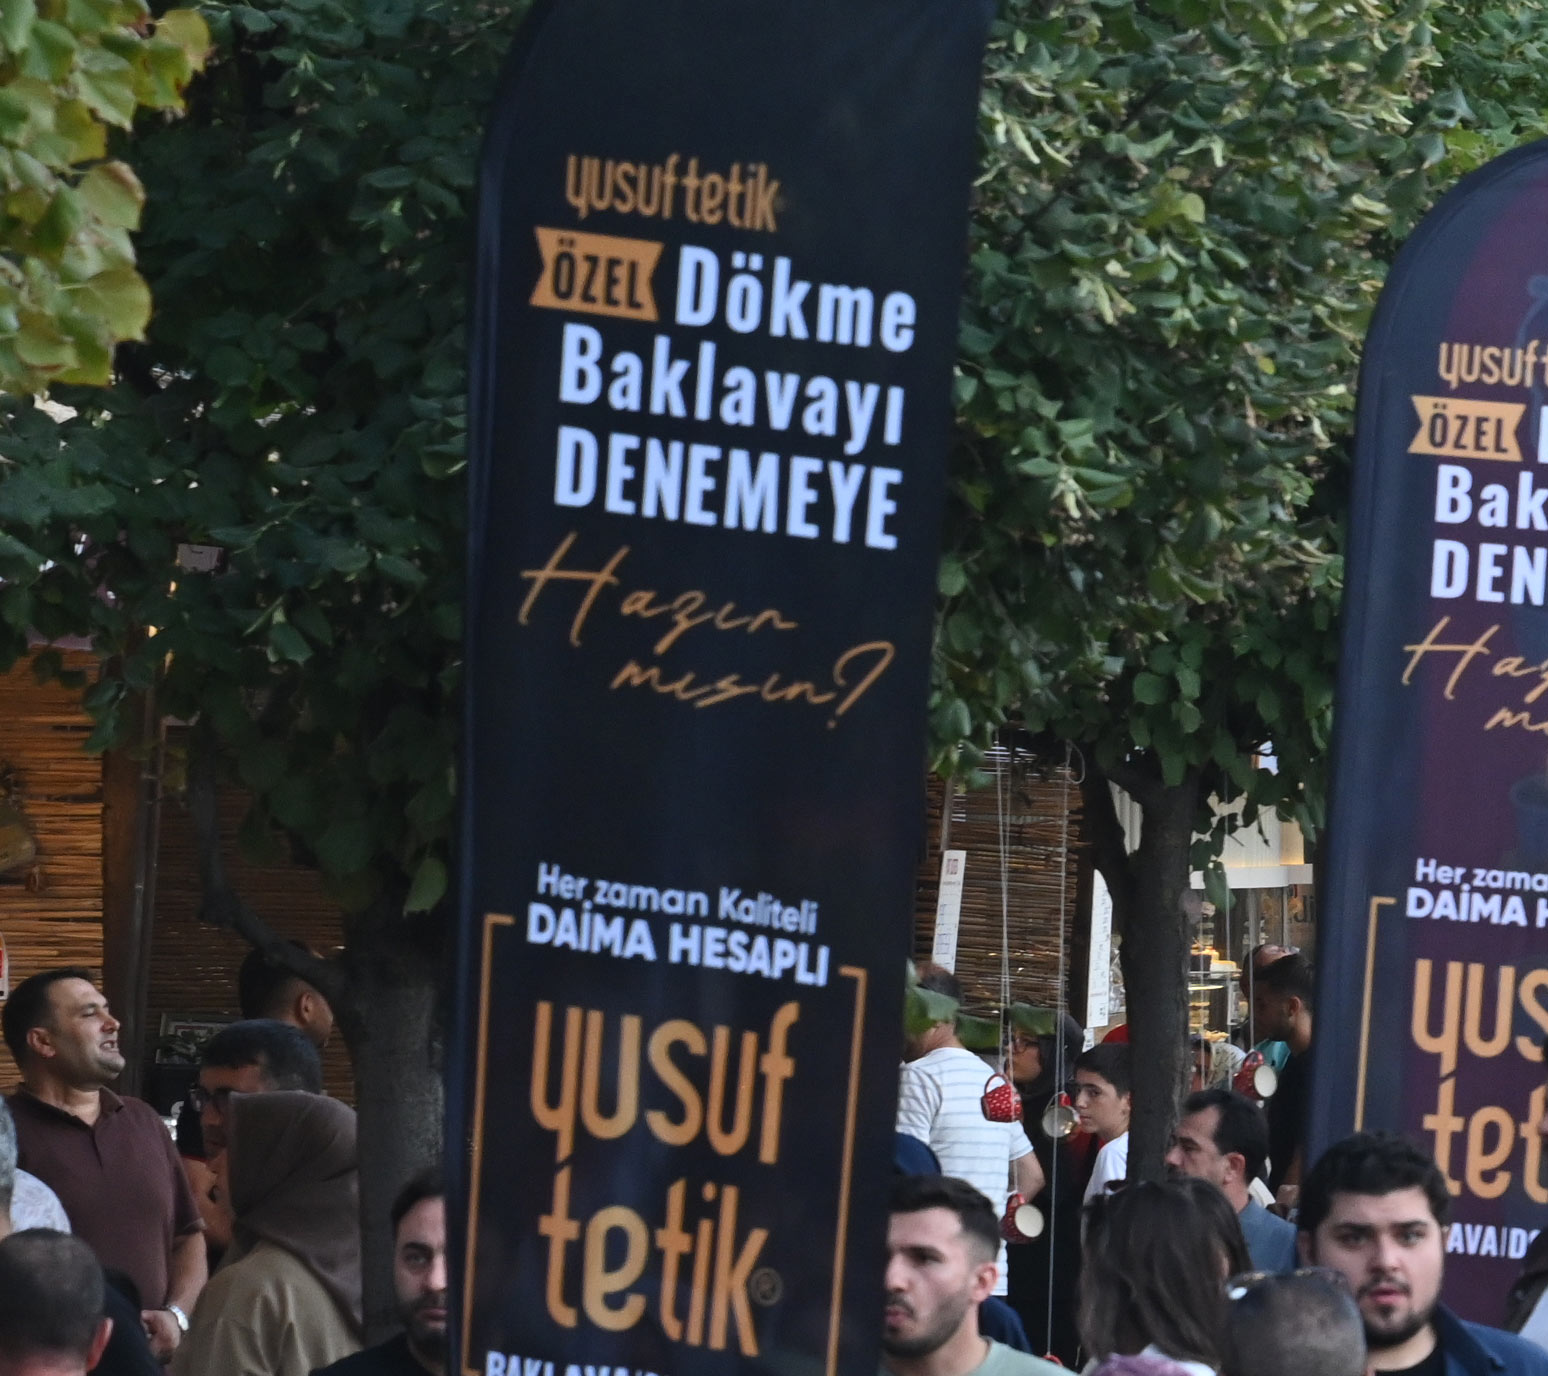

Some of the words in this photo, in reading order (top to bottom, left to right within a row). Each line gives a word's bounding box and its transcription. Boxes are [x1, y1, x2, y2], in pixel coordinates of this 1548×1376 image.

[550, 238, 646, 311] ÖZEL
[675, 244, 917, 353] Dökme
[559, 322, 905, 455] Baklavayı
[1427, 405, 1509, 454] ÖZEL
[554, 424, 904, 551] DENEMEYE
[536, 862, 588, 900] Her
[594, 876, 709, 919] zaman
[717, 887, 818, 936] Kaliteli
[1406, 881, 1528, 927] DAİMA
[1415, 857, 1462, 886] Her
[526, 892, 657, 963] DAİMA
[668, 923, 831, 987] HESAPLI
[530, 1000, 800, 1165] yusuf
[538, 1165, 768, 1357] tetik
